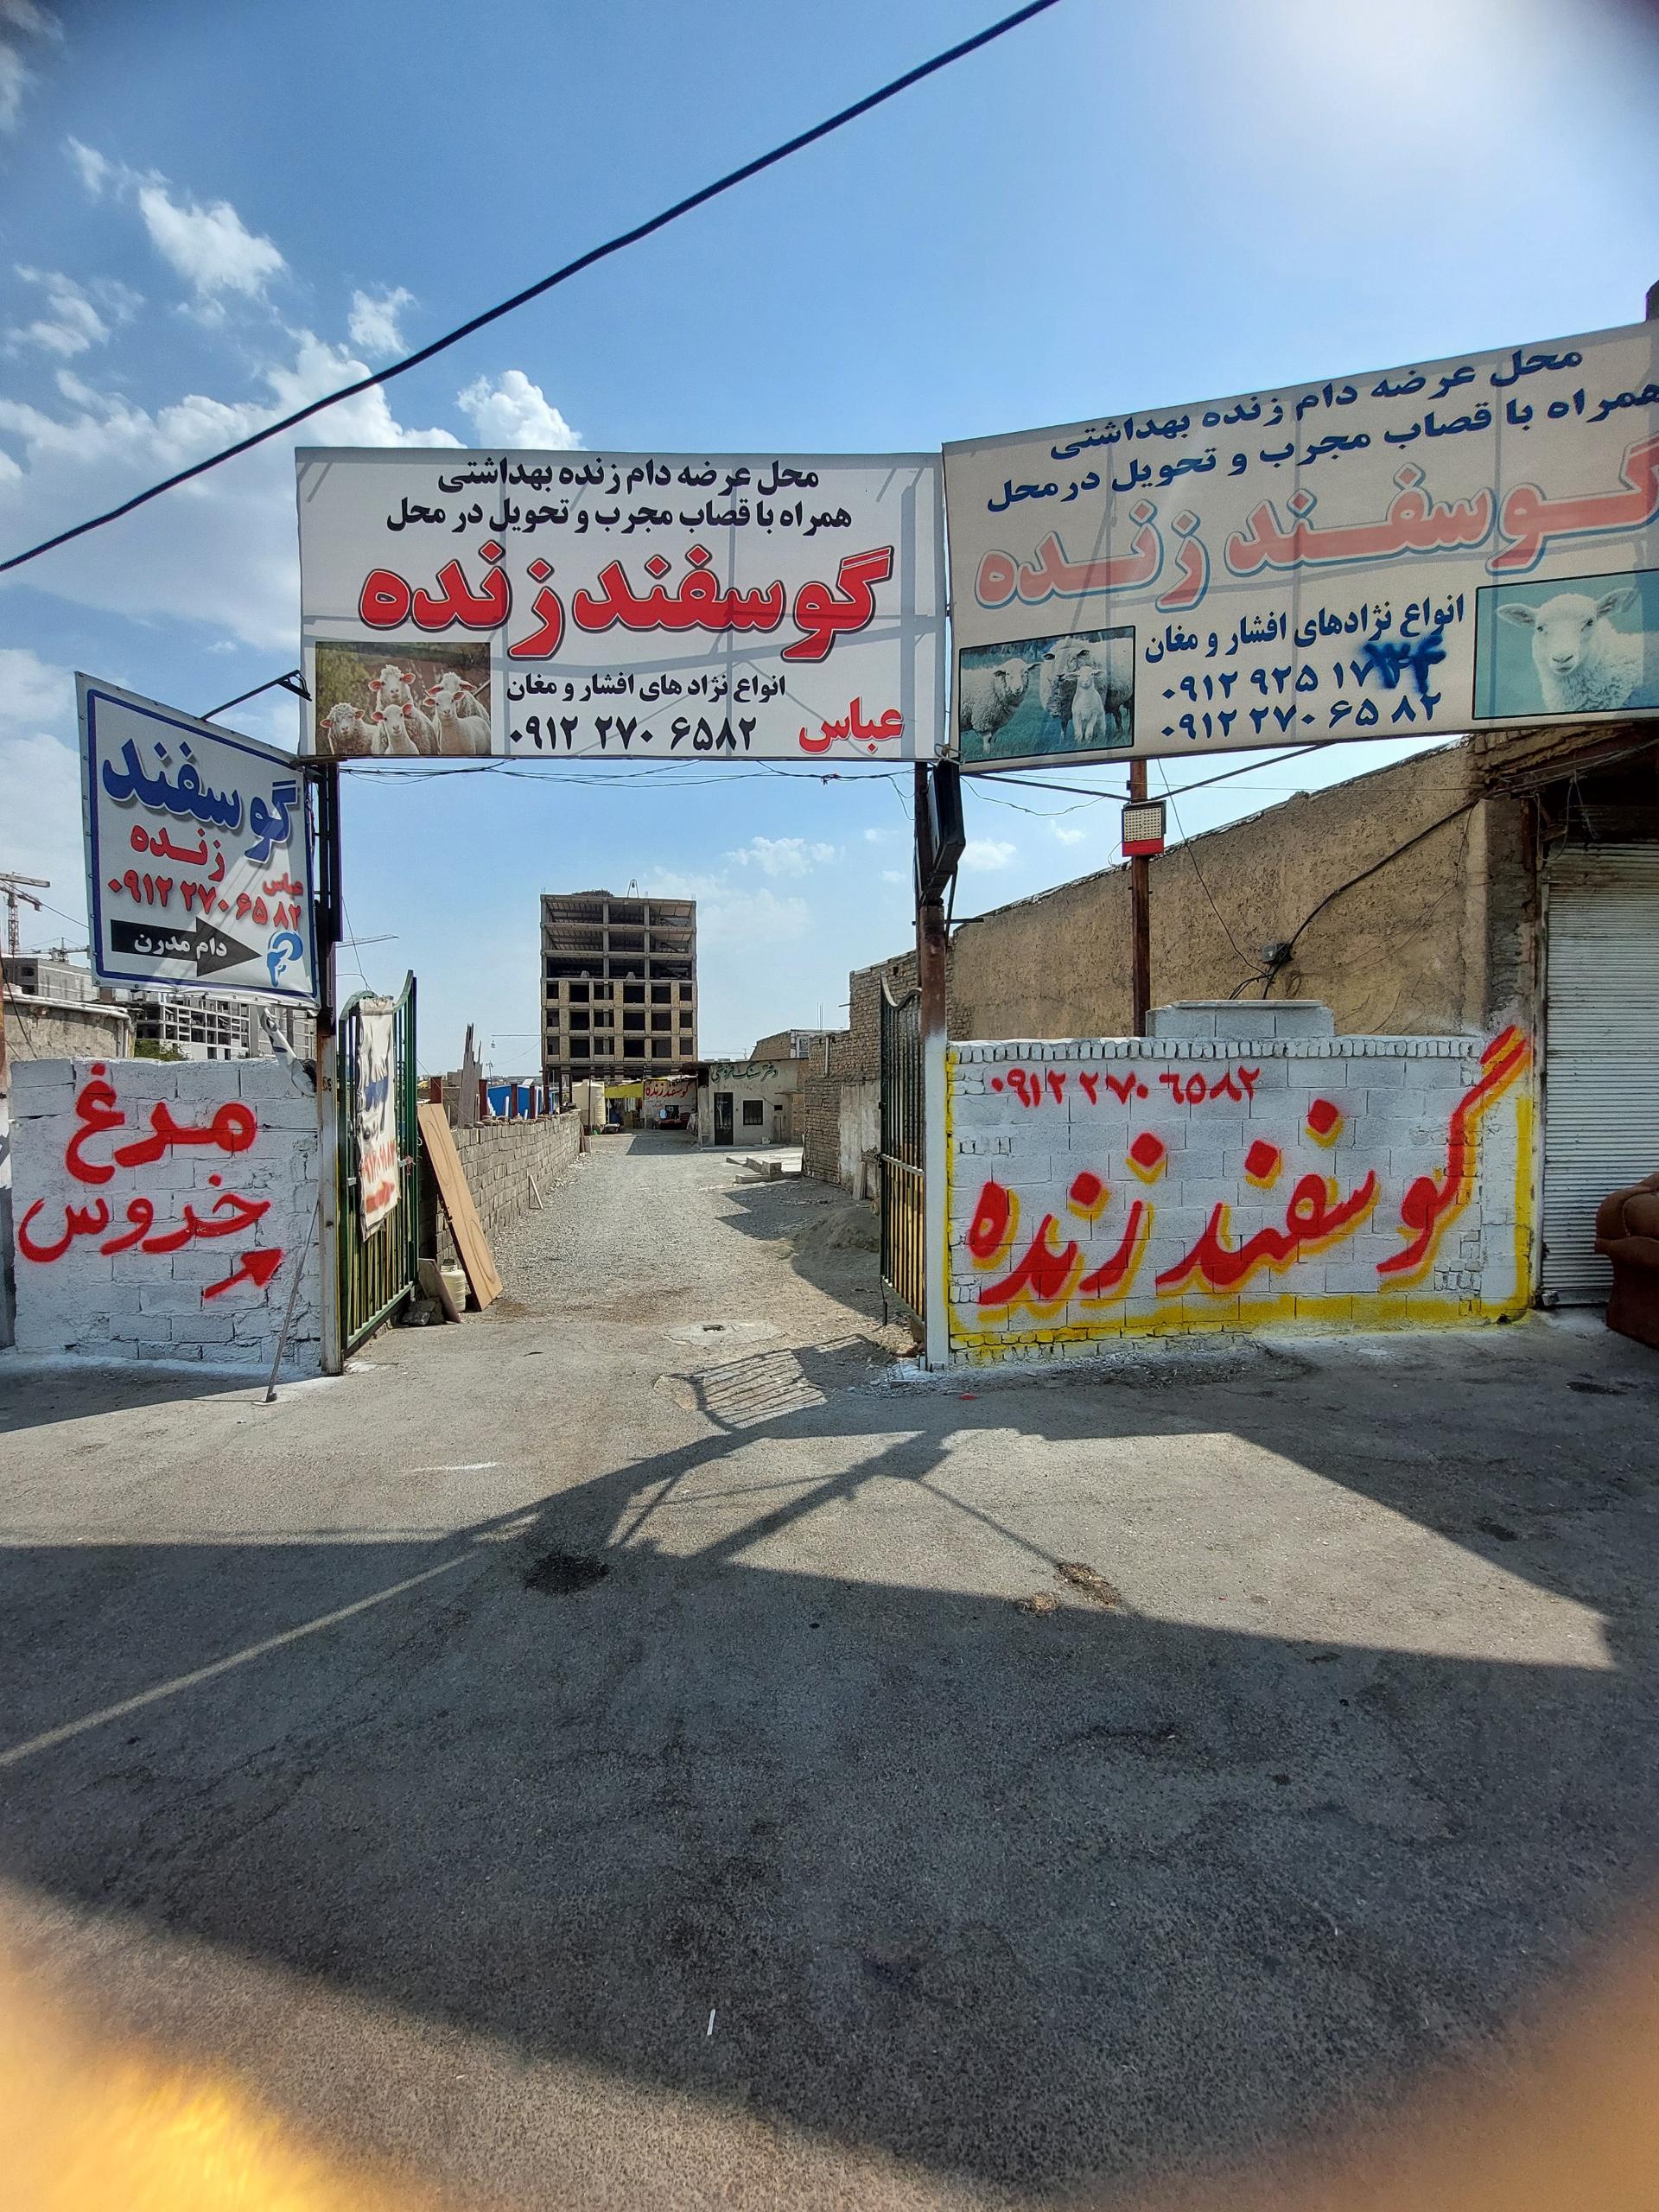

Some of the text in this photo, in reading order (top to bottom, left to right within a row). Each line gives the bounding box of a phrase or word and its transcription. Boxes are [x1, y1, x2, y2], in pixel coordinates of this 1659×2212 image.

[1050, 349, 1583, 461] محل عرضه دام زنده بهداشتی
[987, 383, 1659, 512] همراه با قصاب مجرب و تحویل در محل
[438, 456, 819, 496] محل عرضه دام زنده بهداشتی
[387, 497, 853, 536] همراه با قصاب مجرب و تحویل در محل
[975, 432, 1659, 614] گوسفند زنده
[358, 539, 896, 663] گوسفند زنده
[1400, 594, 1465, 639] انواع
[1145, 624, 1198, 664] مغان
[1205, 631, 1218, 658] و
[1225, 611, 1287, 657] افشار
[506, 672, 557, 702] مغان
[562, 682, 574, 702] و
[579, 671, 634, 702] افشار
[733, 673, 785, 703] انواع
[1161, 671, 1238, 702] ۰۹۱۲
[1249, 664, 1319, 695] ۹۲۵
[510, 715, 579, 750] ۰۹۱۲
[594, 715, 654, 750] ۲۷۰
[798, 696, 904, 753] عباس
[1160, 709, 1237, 741] ۰۹۱۲
[1249, 704, 1316, 734] ۲۷۰
[101, 738, 299, 863] گوسفند
[130, 824, 225, 882] زنده
[108, 869, 173, 907] ۰۹۱۲
[263, 872, 303, 900] عباس
[134, 933, 228, 960] دام مدرن
[967, 1025, 1529, 1308] گوسفند زنده
[18, 1173, 271, 1263] خروس
